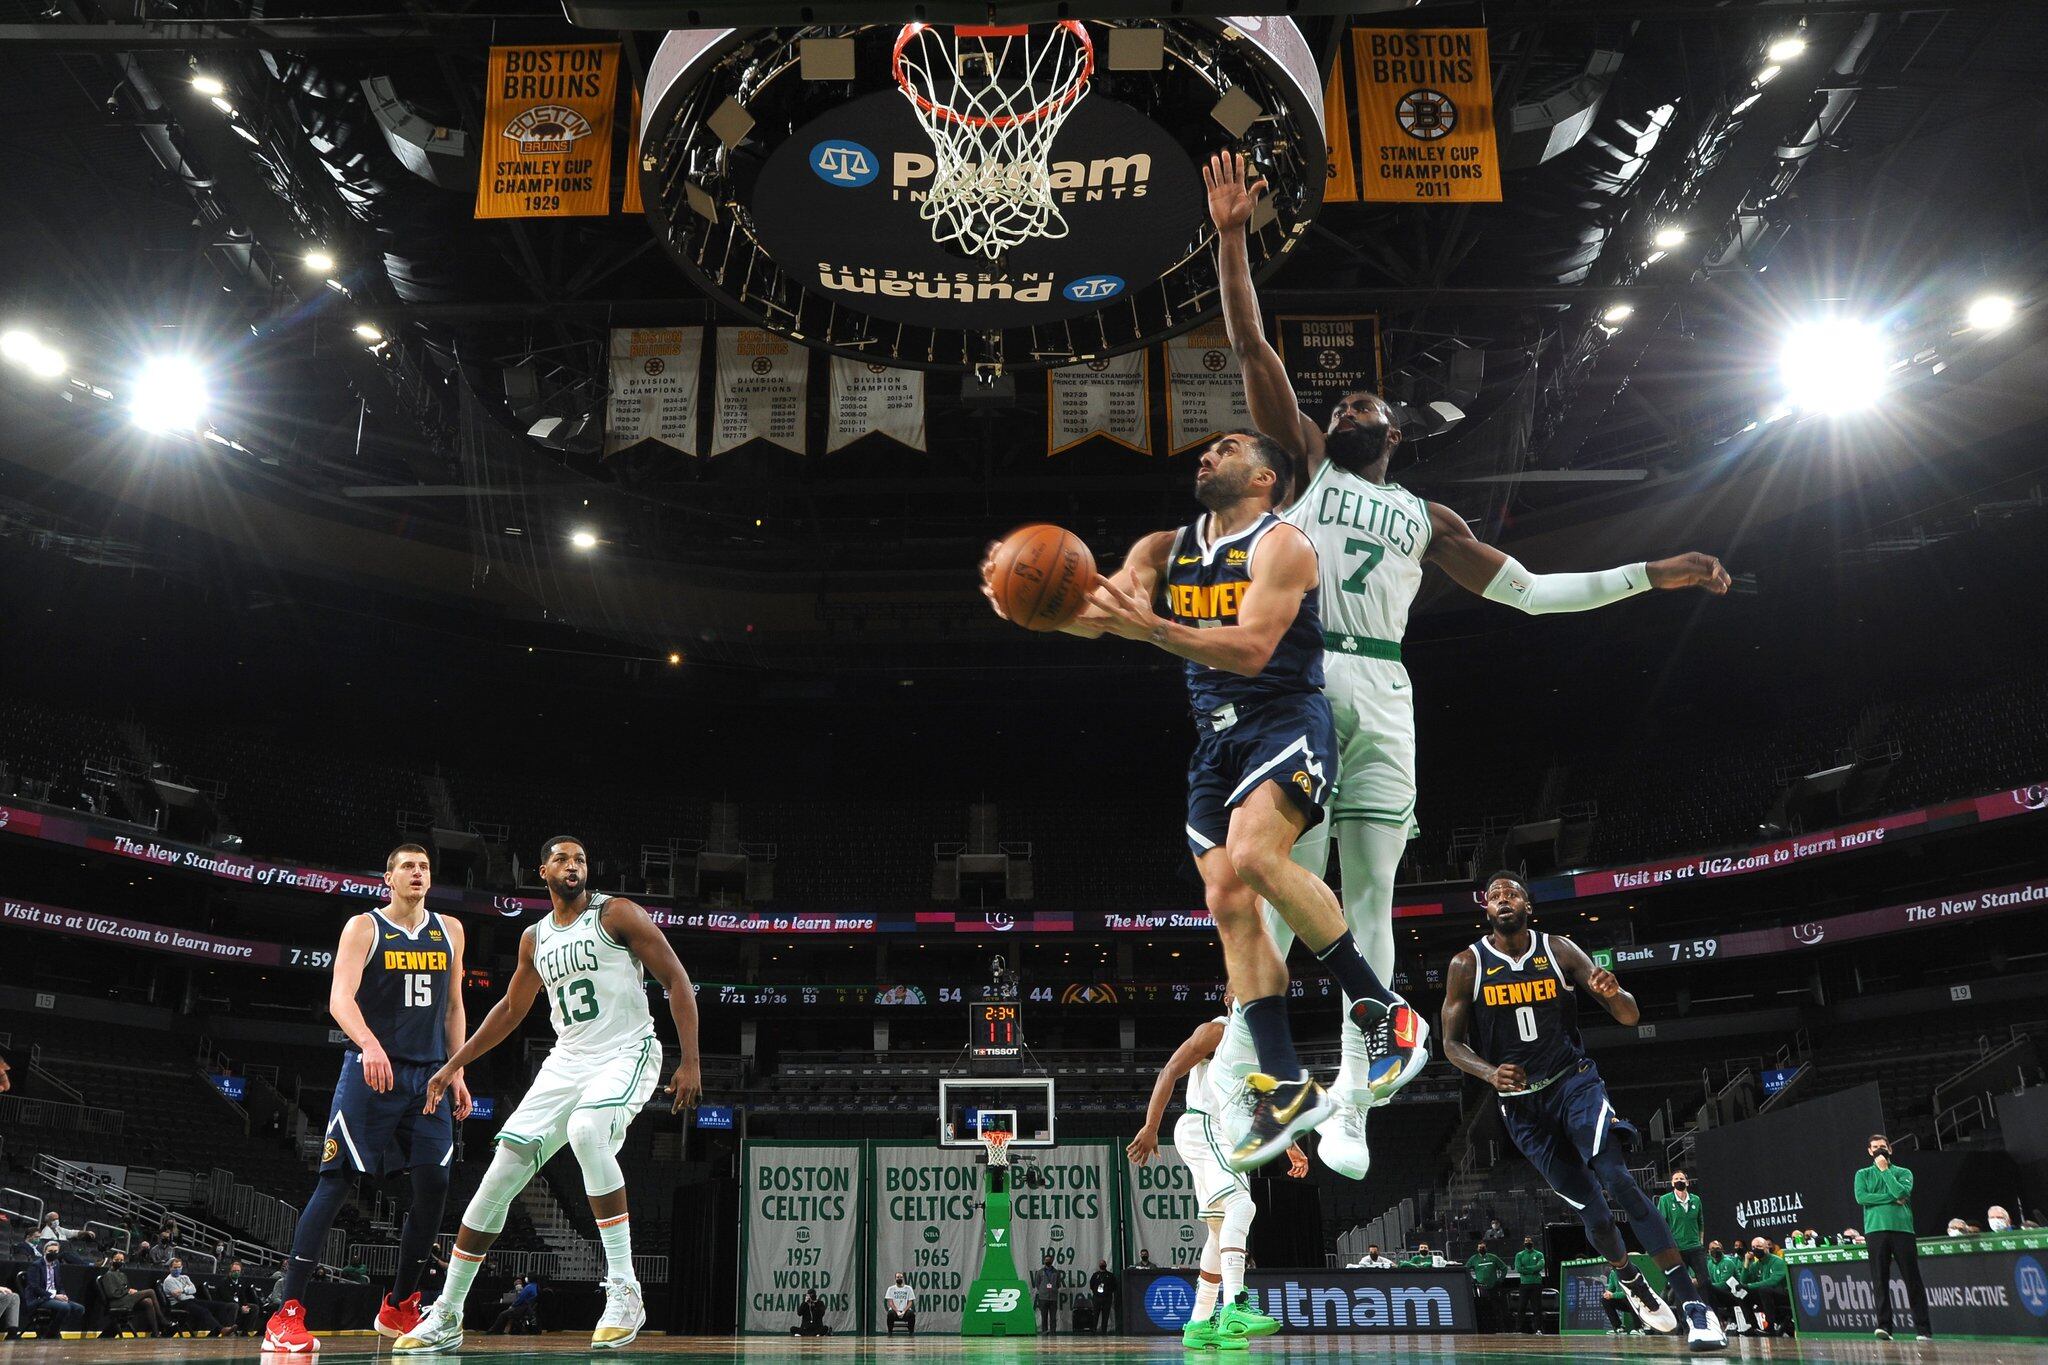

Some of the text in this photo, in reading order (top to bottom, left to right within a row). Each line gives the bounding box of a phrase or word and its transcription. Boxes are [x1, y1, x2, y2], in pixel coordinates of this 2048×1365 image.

[1371, 34, 1472, 57] BOSTON
[505, 49, 602, 73] BOSTON
[1373, 59, 1473, 83] BRUINS
[504, 74, 600, 99] BRUINS
[506, 107, 590, 139] BOSTON
[524, 141, 569, 151] BRUINS
[1380, 146, 1479, 161] STANLEY CUP
[497, 159, 593, 176] STANLEY CUP
[1380, 164, 1483, 179] CHAMPIONS
[494, 177, 593, 194] CHAMPIONS
[1416, 181, 1450, 197] 2011
[524, 196, 560, 210] 1929
[820, 272, 1053, 303] Putnam
[1302, 322, 1354, 334] BOSTON
[1303, 336, 1355, 347] BRUINS
[629, 378, 676, 386] DIVISION
[1318, 487, 1420, 557] CELTICS
[1341, 537, 1386, 596] 7
[114, 836, 339, 893] The New Standard of Facility
[1613, 826, 1885, 888] Visit us at UG2.com to learn more
[1906, 899, 1977, 922] The New
[3, 902, 253, 957] Visit us at UG2.com to learn more
[667, 913, 873, 929] us at UG2.com to learn more
[1104, 914, 1166, 928] The New
[1793, 922, 1825, 940] UG2
[290, 948, 332, 968] 7:59
[1616, 948, 1654, 962] Bank
[1669, 939, 1717, 961] 7:59
[384, 950, 447, 971] DENVER
[539, 939, 599, 987] CELTICS
[404, 973, 432, 1007] 15
[721, 986, 736, 994] 3PT
[938, 987, 962, 1003] 54
[1030, 987, 1053, 1002] 44
[1172, 984, 1190, 992] FG%
[1174, 992, 1188, 1001] 47
[1483, 978, 1557, 1006] DENVER
[1953, 987, 1967, 999] 19
[556, 978, 600, 1027] 13
[720, 994, 746, 1004] 7/21
[754, 994, 787, 1004] 19/36
[803, 994, 816, 1004] 53
[985, 1006, 1015, 1021] 2:34
[989, 1022, 1013, 1043] 11
[1515, 1006, 1539, 1042] 0
[985, 1048, 1019, 1056] TISSOT
[759, 1166, 849, 1192] BOSTON
[886, 1166, 977, 1192] BOSTON
[1138, 1164, 1195, 1190] BOST
[761, 1195, 845, 1221] CELTICS
[889, 1195, 975, 1221] CELTICS
[1014, 1194, 1099, 1220] CELTICS
[1745, 1191, 1804, 1217] ARBELLA
[1752, 1213, 1798, 1228] INSURANCE
[796, 1231, 811, 1239] NBA
[924, 1231, 939, 1239] NBA
[1050, 1230, 1065, 1238] NBA
[1180, 1230, 1195, 1238] NBA
[787, 1248, 822, 1266] 1957
[914, 1248, 950, 1267] 1965
[1040, 1247, 1075, 1265] 1969
[773, 1270, 831, 1289] WORLD
[904, 1271, 961, 1290] WORLD
[753, 1293, 849, 1312] CHAMONS
[1820, 1275, 1911, 1311] Putnm
[1926, 1284, 2009, 1306] LWAYS ACTIVE
[1217, 1281, 1454, 1328] utnam
